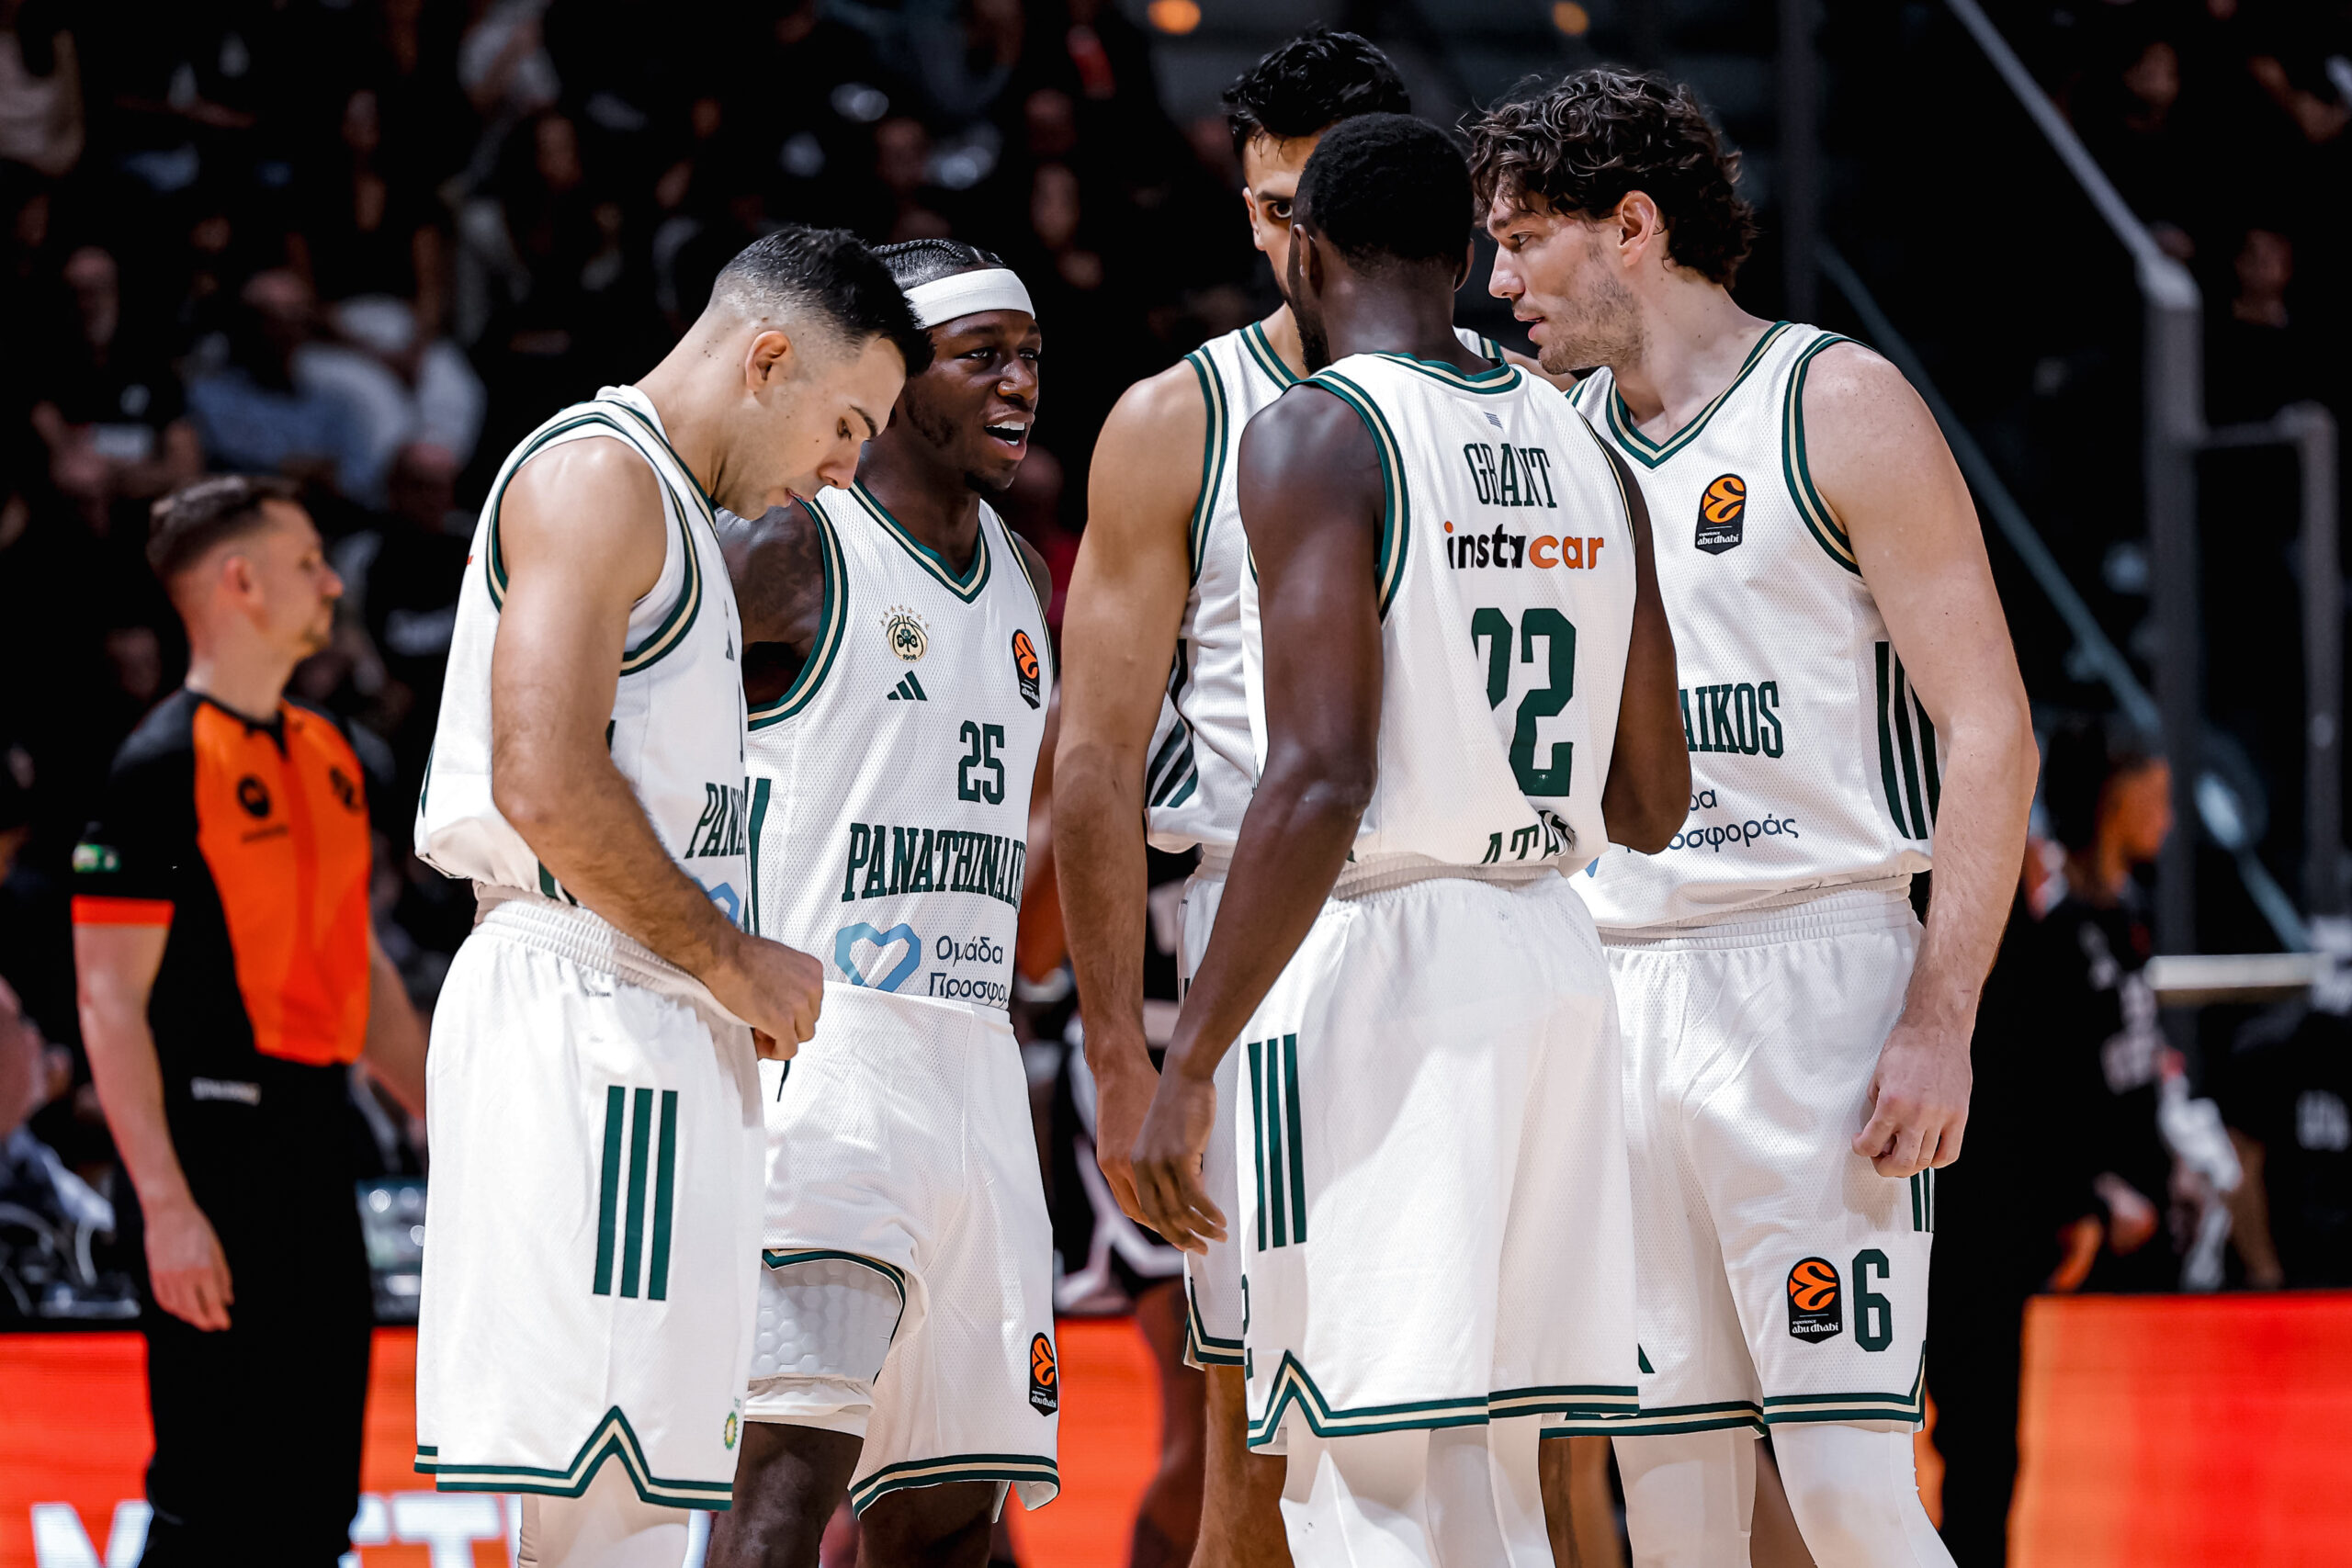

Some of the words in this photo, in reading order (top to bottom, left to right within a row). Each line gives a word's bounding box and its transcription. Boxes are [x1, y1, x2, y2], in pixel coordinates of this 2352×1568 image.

[1463, 442, 1558, 509] GRANT
[1443, 520, 1604, 570] instacar
[1697, 536, 1713, 546] abu
[1713, 533, 1739, 544] dhabi
[957, 719, 1005, 806] 25
[935, 935, 1003, 966] Ομάδα
[1852, 1248, 1893, 1352] 6
[1792, 1325, 1810, 1334] abu
[1810, 1322, 1838, 1333] dhabi
